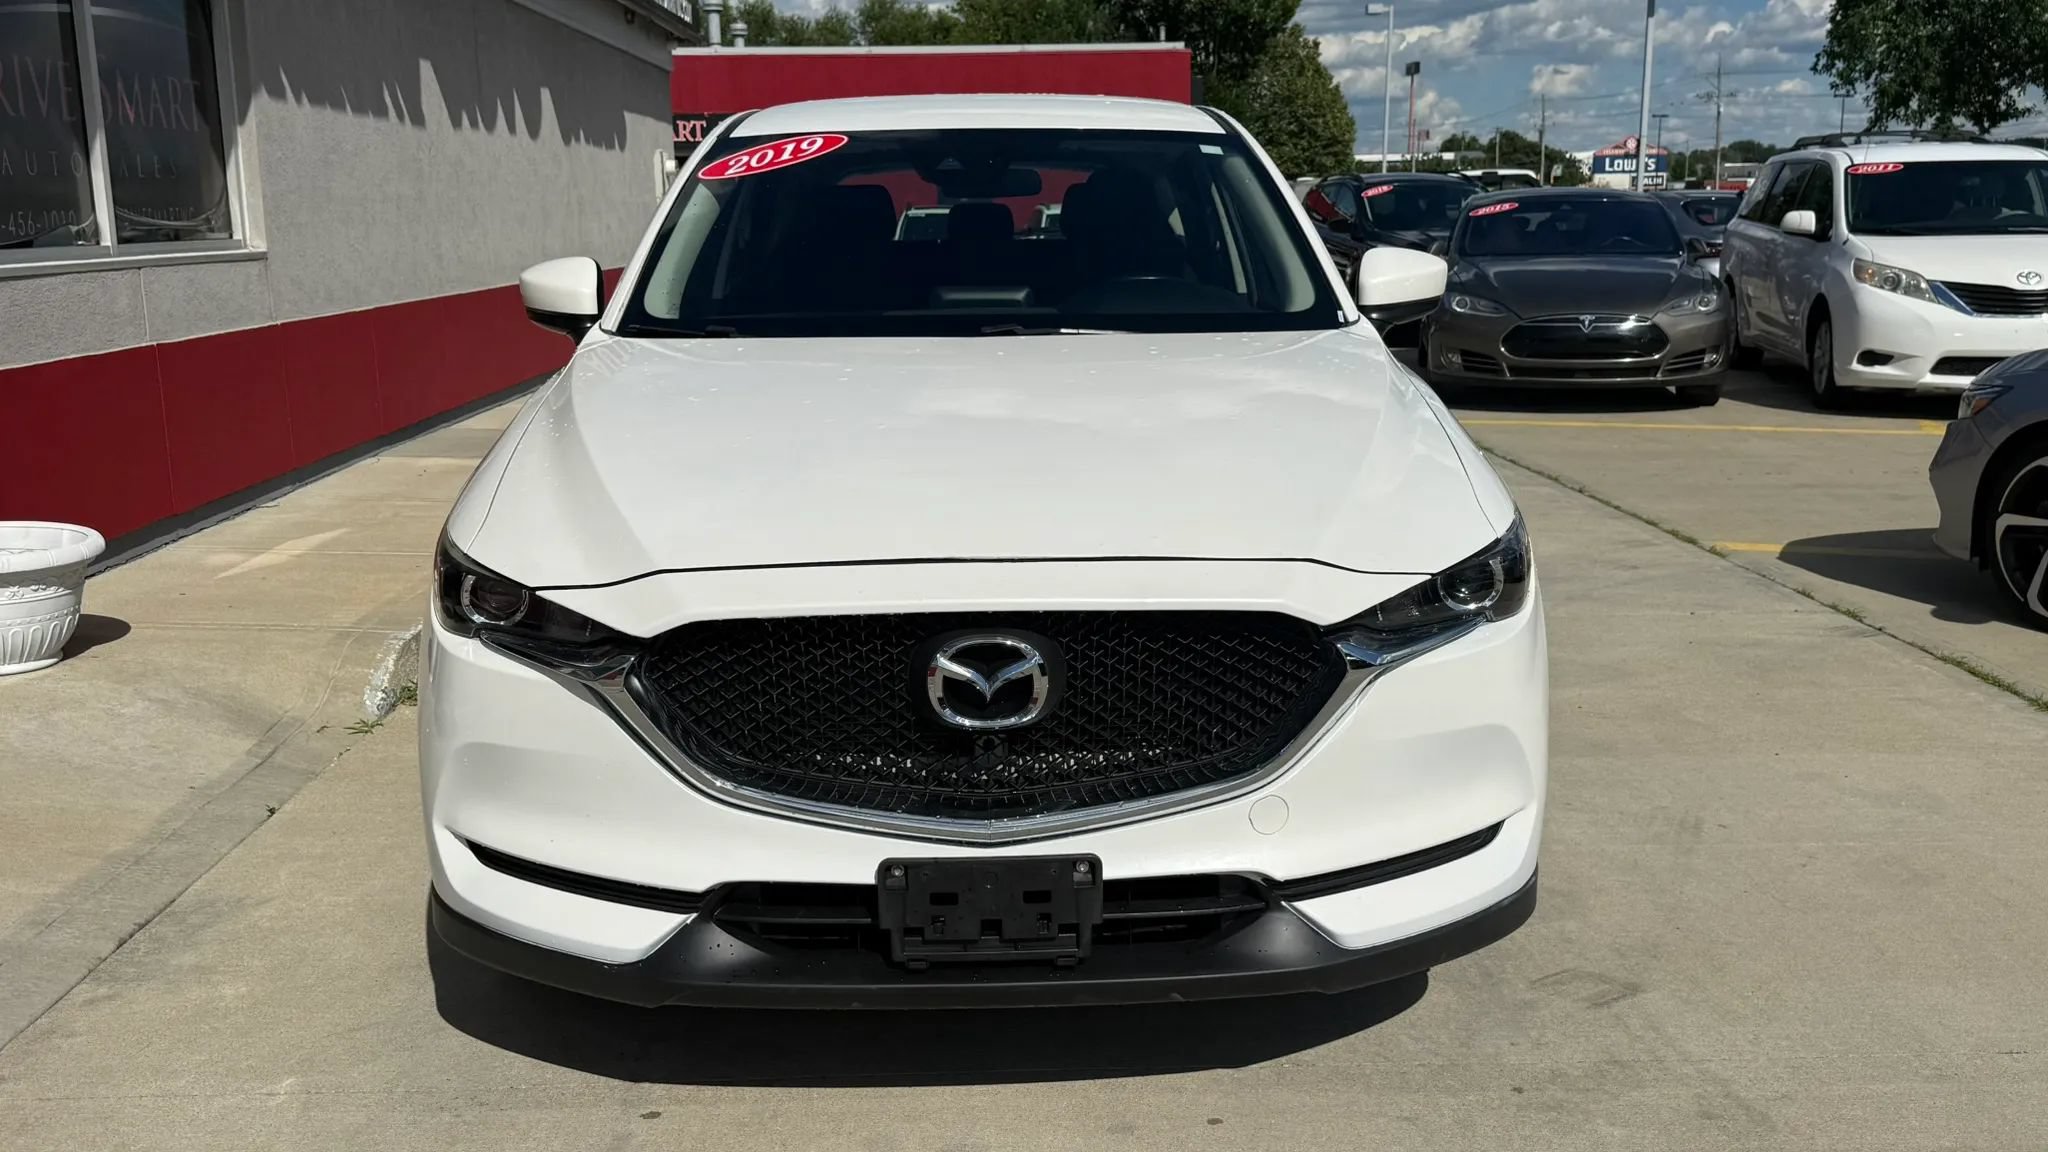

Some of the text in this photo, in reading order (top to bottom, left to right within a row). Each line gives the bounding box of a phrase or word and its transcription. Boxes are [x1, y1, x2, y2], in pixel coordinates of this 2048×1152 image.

[672, 120, 706, 142] RT
[2, 148, 177, 179] AUTO ALES
[723, 136, 825, 177] 2019
[1604, 157, 1657, 172] LOW'S
